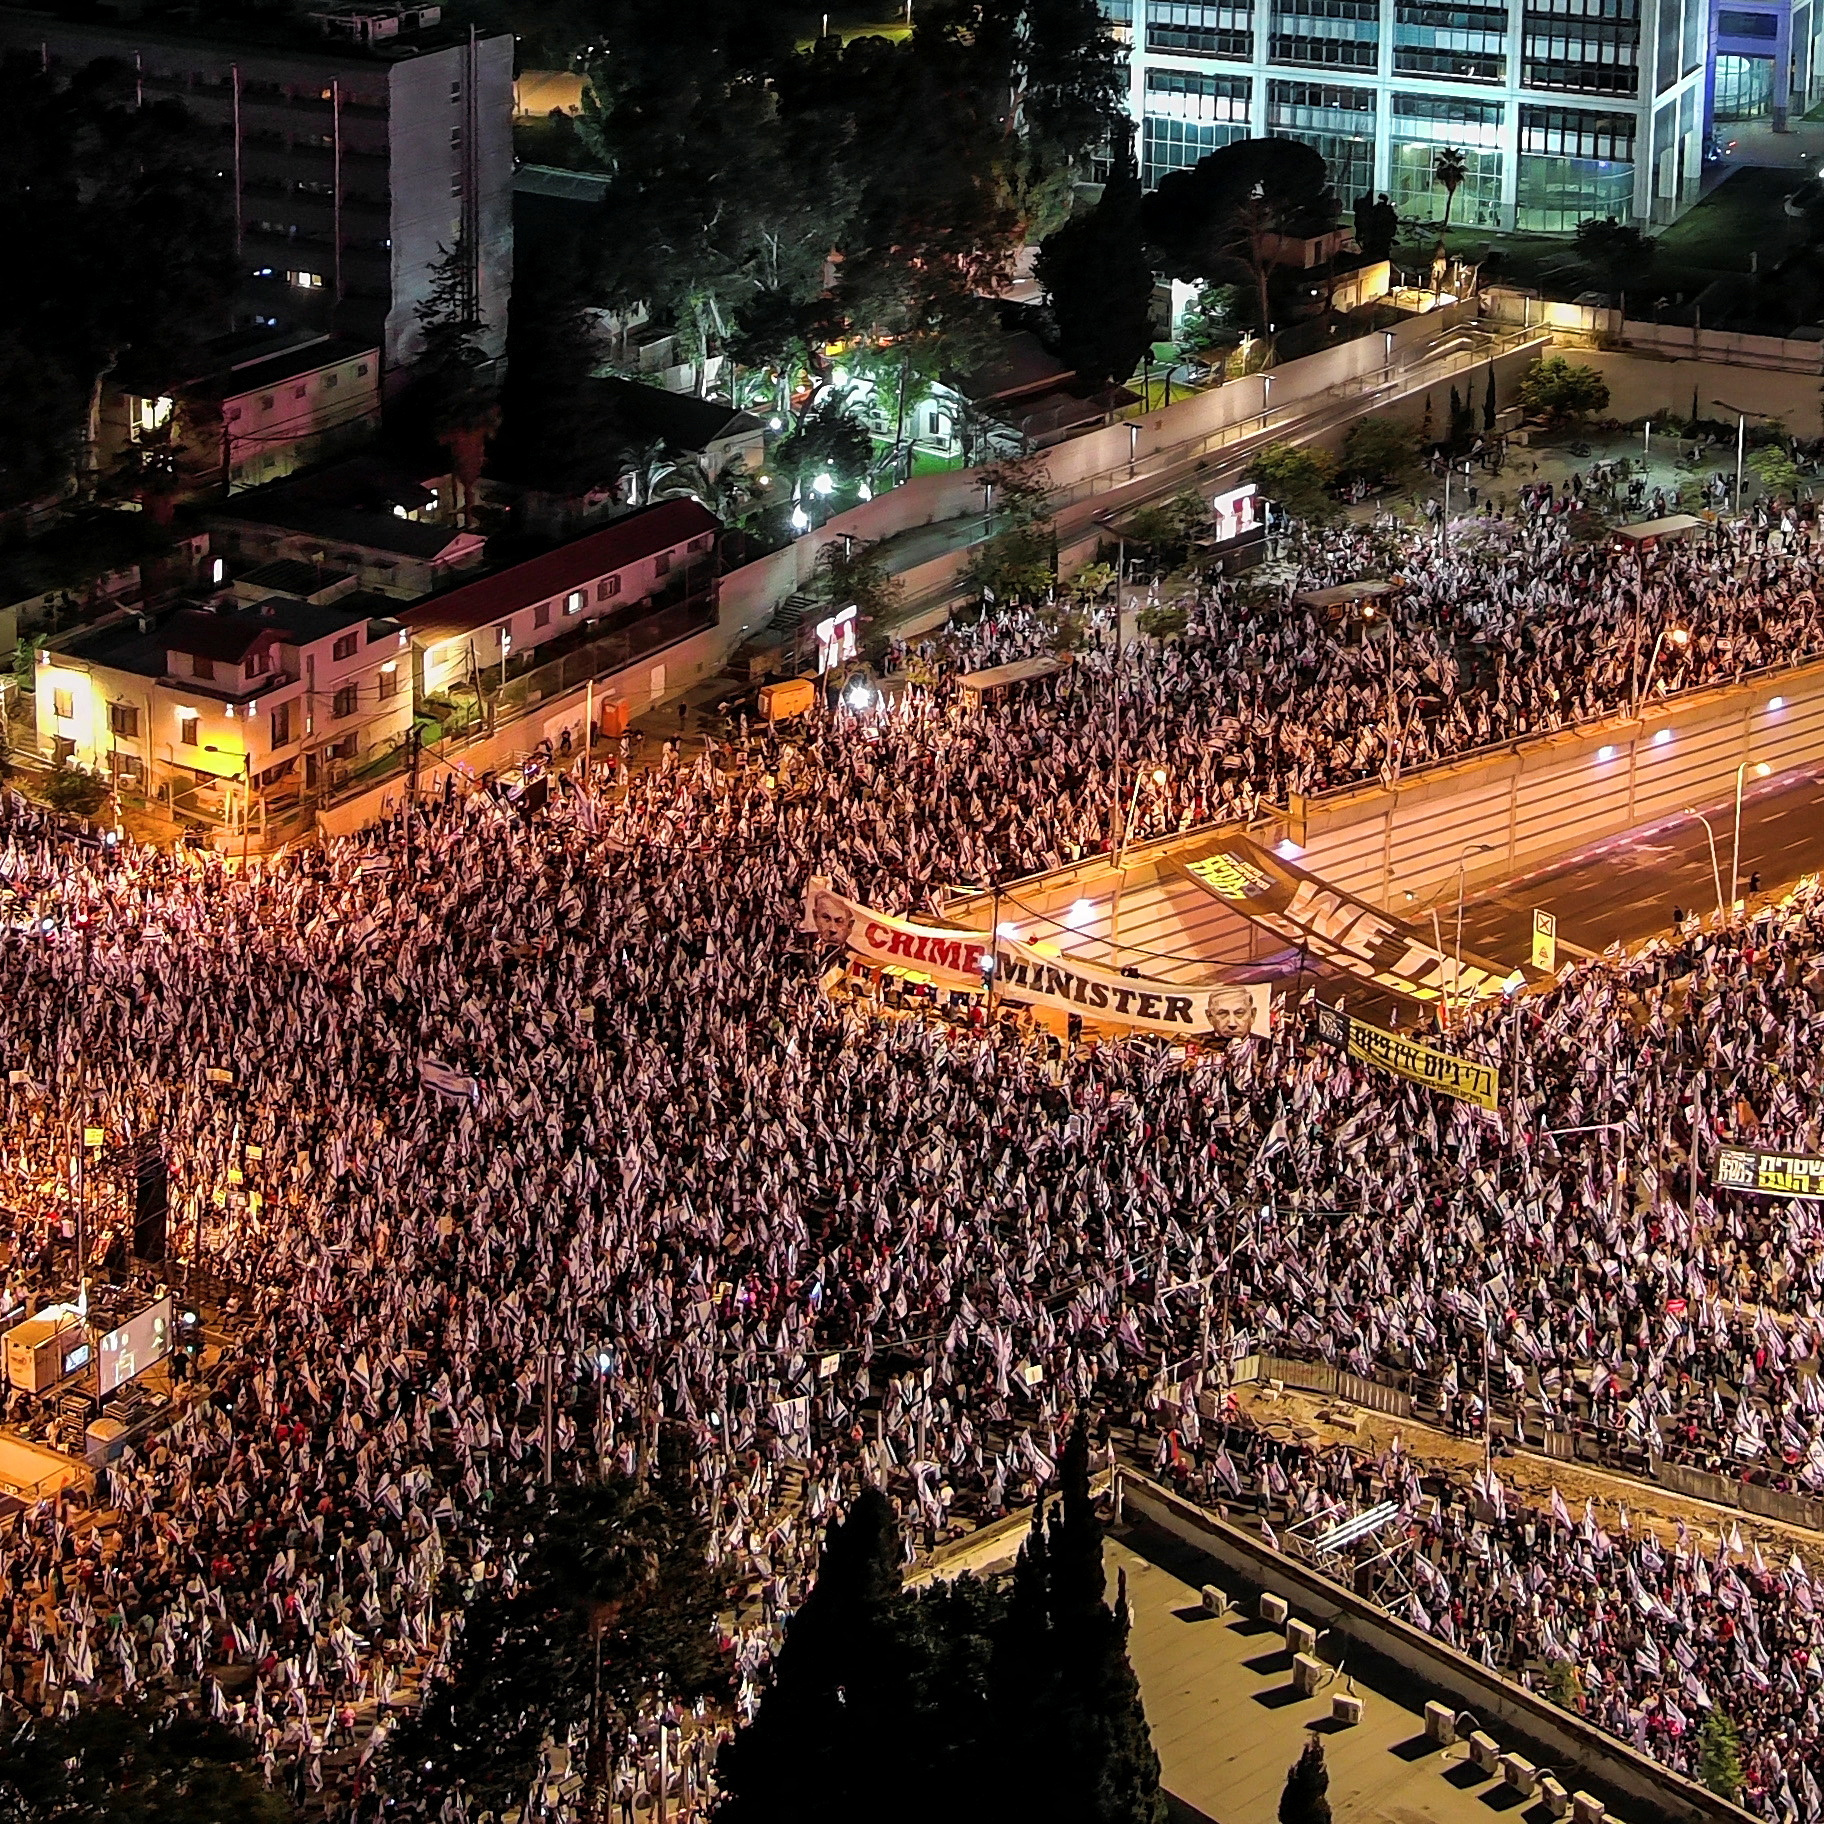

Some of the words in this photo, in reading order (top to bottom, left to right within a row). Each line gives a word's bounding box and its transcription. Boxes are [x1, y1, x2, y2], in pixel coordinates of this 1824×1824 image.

[1283, 879, 1397, 959] WE
[864, 922, 986, 975] CRIME
[996, 950, 1194, 1024] MINISTER
